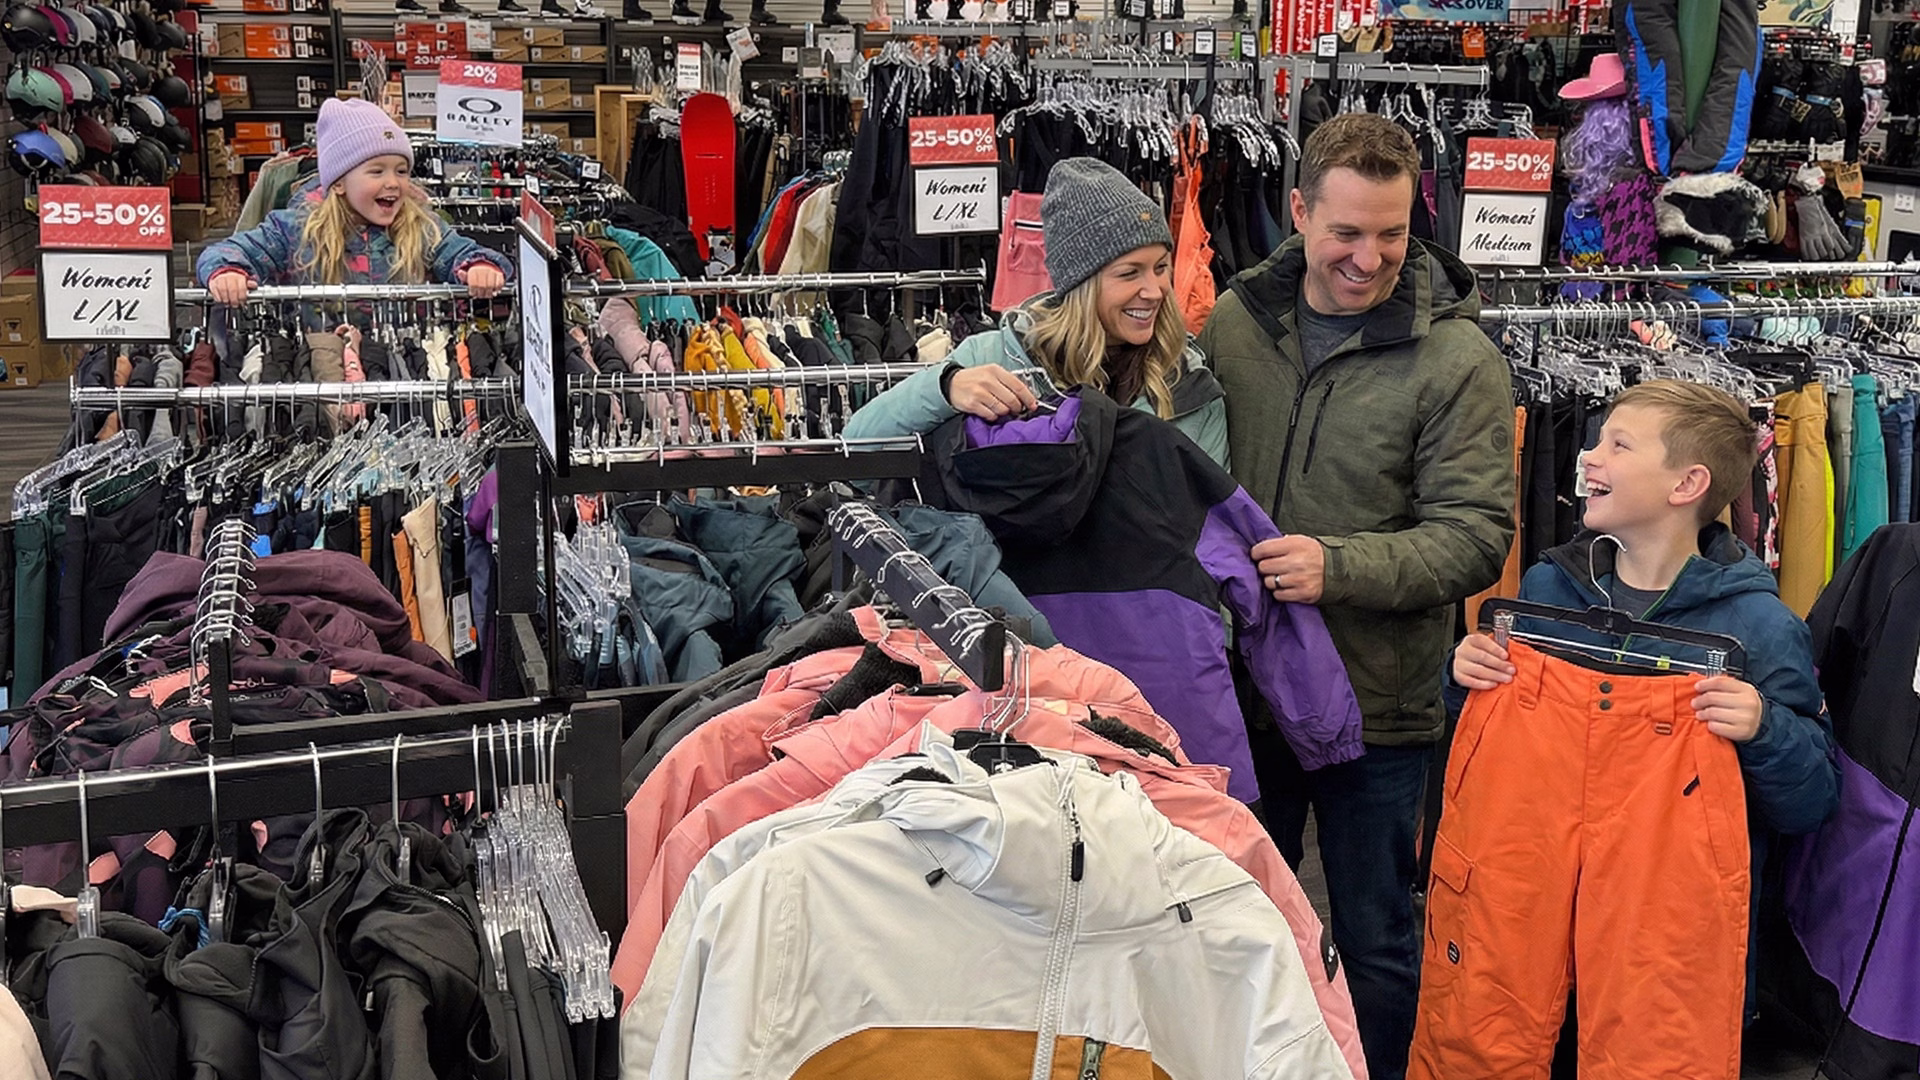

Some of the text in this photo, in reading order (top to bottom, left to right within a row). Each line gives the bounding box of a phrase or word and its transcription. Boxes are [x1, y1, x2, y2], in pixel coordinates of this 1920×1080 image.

[463, 65, 497, 79] 20%
[447, 112, 512, 126] OAKLEY
[911, 127, 993, 147] 25-50%
[1467, 151, 1551, 172] 25-50%
[43, 202, 166, 226] 25-50%
[933, 201, 978, 221] L/XL
[139, 226, 166, 236] OFF
[72, 298, 140, 324] L/XL
